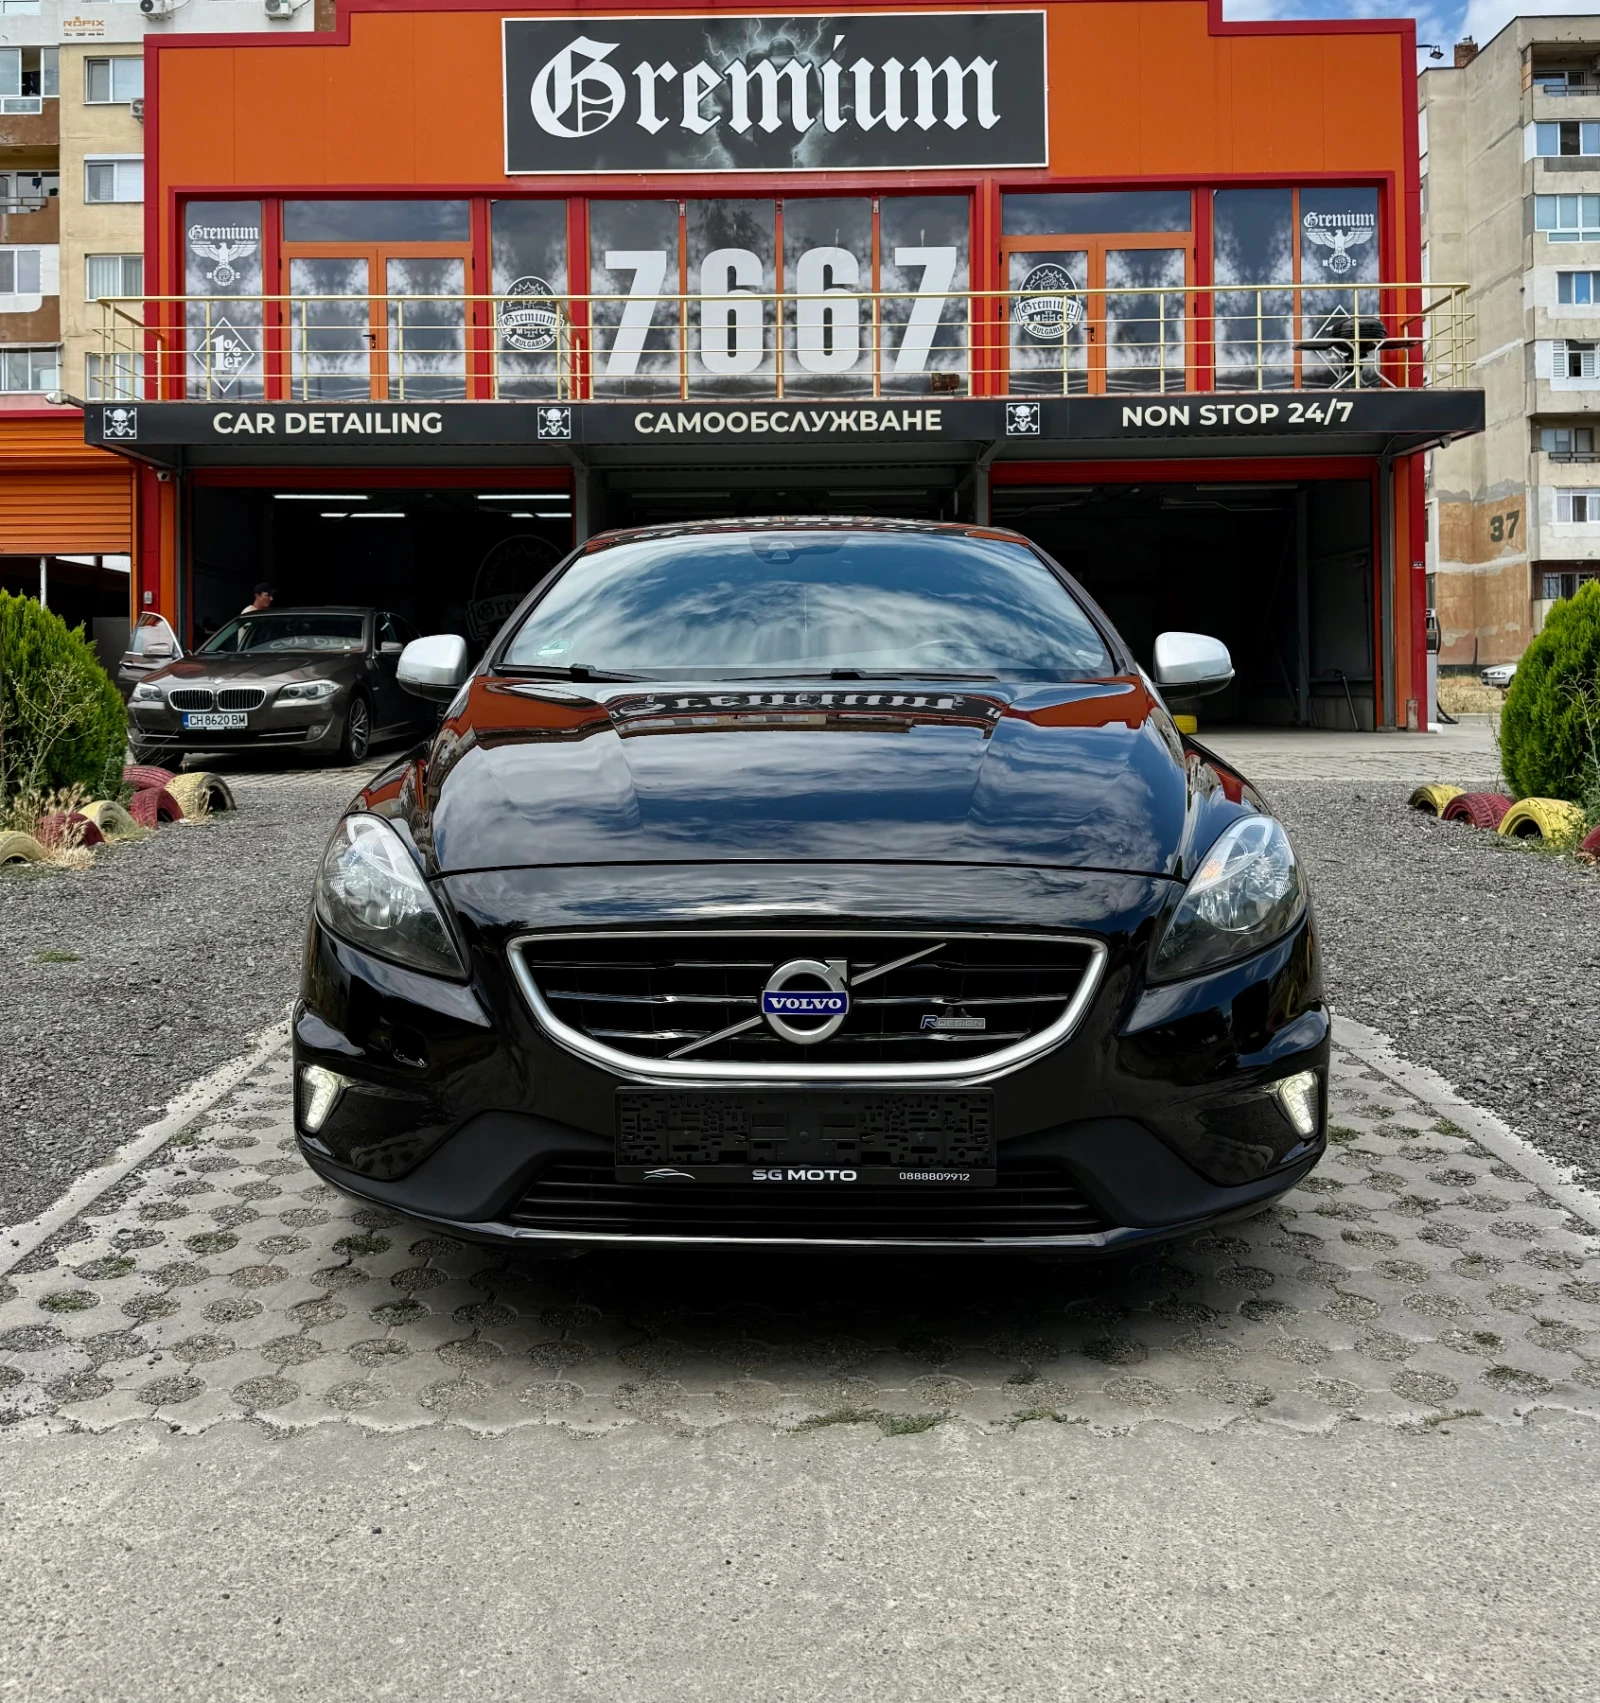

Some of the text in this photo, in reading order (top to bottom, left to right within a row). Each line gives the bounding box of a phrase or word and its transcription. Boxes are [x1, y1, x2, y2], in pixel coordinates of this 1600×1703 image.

[530, 34, 1001, 138] Gremium
[1303, 209, 1375, 228] Gremium
[188, 222, 259, 240] Gremium
[1031, 324, 1064, 335] BULGARIA
[514, 337, 547, 348] BULGARIA
[634, 409, 942, 433] САМООБСЛУЖВАНЕ
[1122, 398, 1354, 427] NON STOP 24/7
[213, 412, 443, 434] CAR DETAILING
[1490, 510, 1520, 543] 37
[204, 714, 230, 726] 8620
[768, 997, 842, 1010] VOLVO
[752, 1169, 971, 1182] SG MOTO 0888809912
